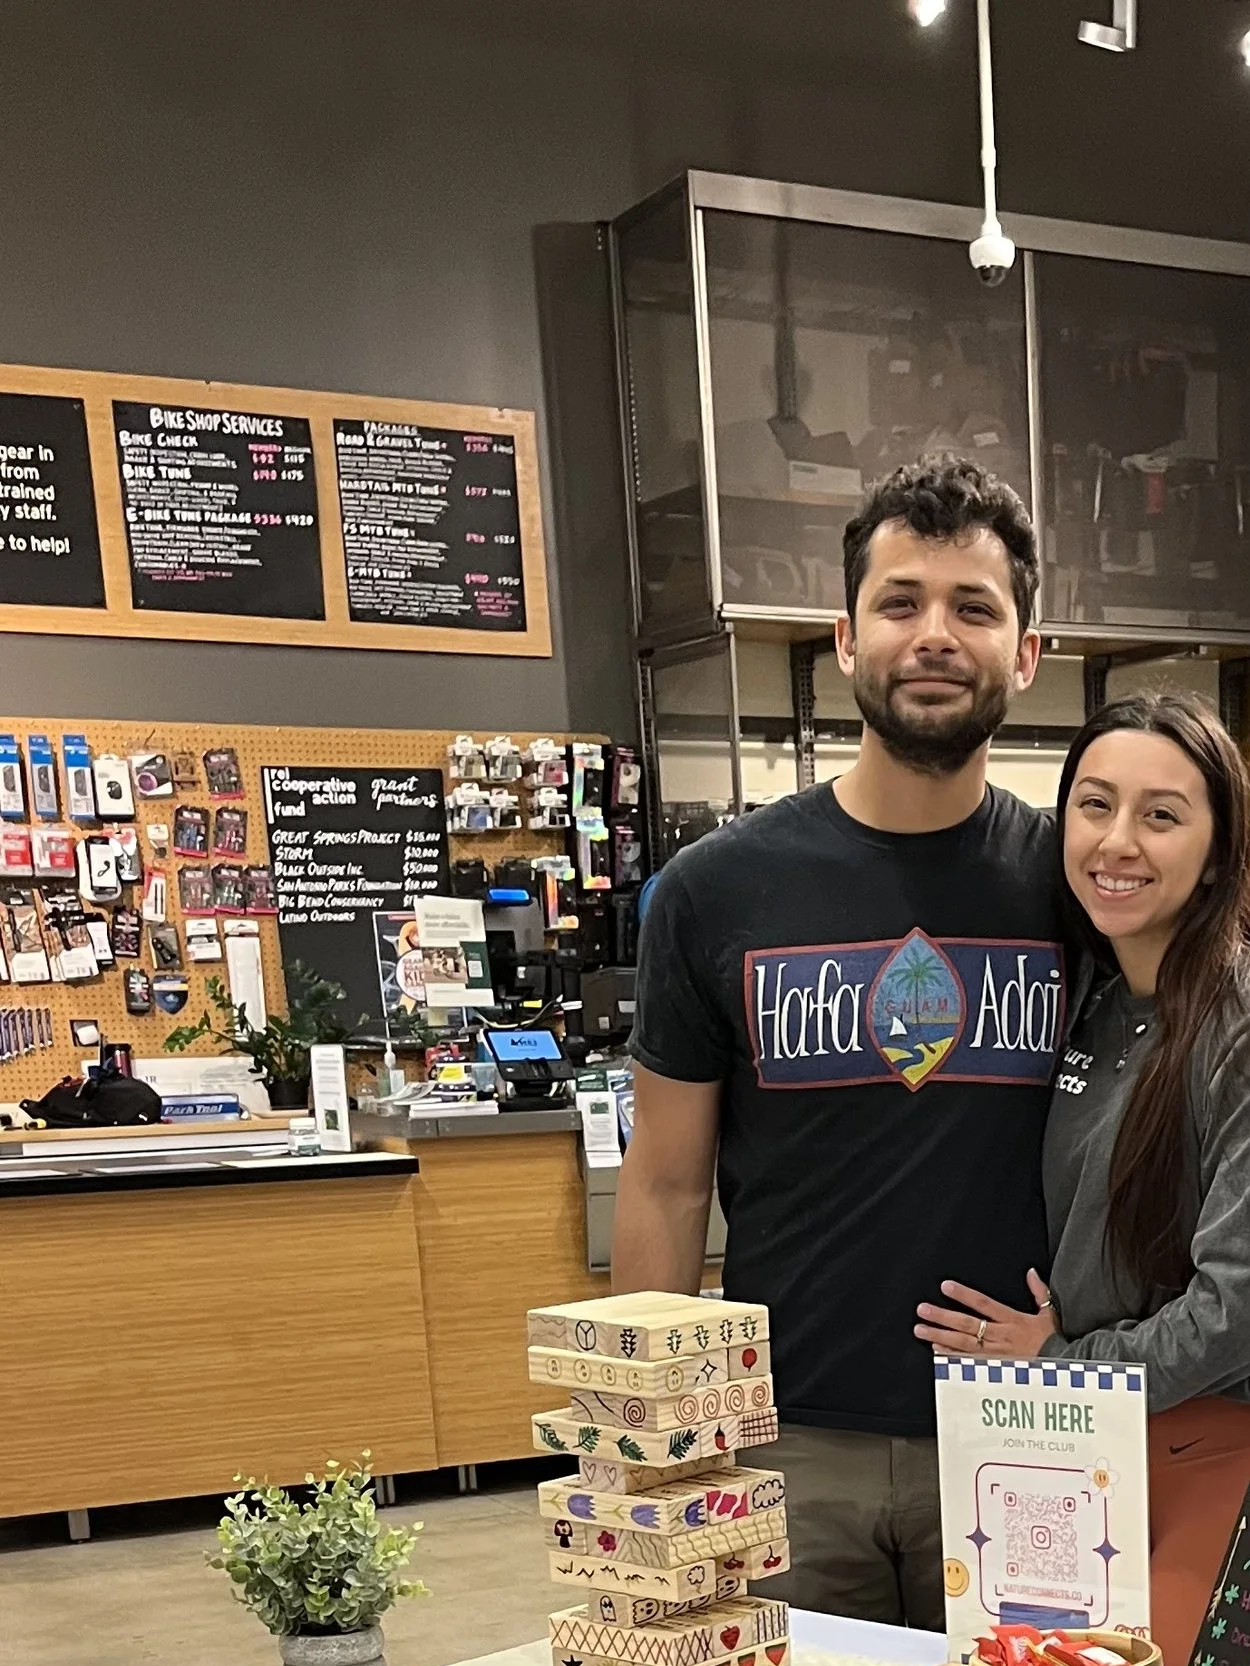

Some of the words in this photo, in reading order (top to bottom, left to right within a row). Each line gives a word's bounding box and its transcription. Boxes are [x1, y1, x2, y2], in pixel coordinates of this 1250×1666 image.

[38, 444, 54, 462] in
[0, 462, 39, 480] from
[15, 502, 57, 521] staff.
[9, 534, 27, 551] to
[31, 535, 70, 556] help!
[272, 777, 356, 795] cooperative
[371, 776, 419, 799] grant
[274, 801, 305, 816] fund
[312, 792, 357, 805] action
[376, 794, 439, 810] partners
[755, 959, 865, 1060] Hafa
[982, 1398, 1035, 1430] SCAN
[1044, 1402, 1095, 1433] HERE
[1002, 1438, 1025, 1449] JOIN
[1027, 1440, 1045, 1450] THE
[1048, 1441, 1075, 1452] CLUB
